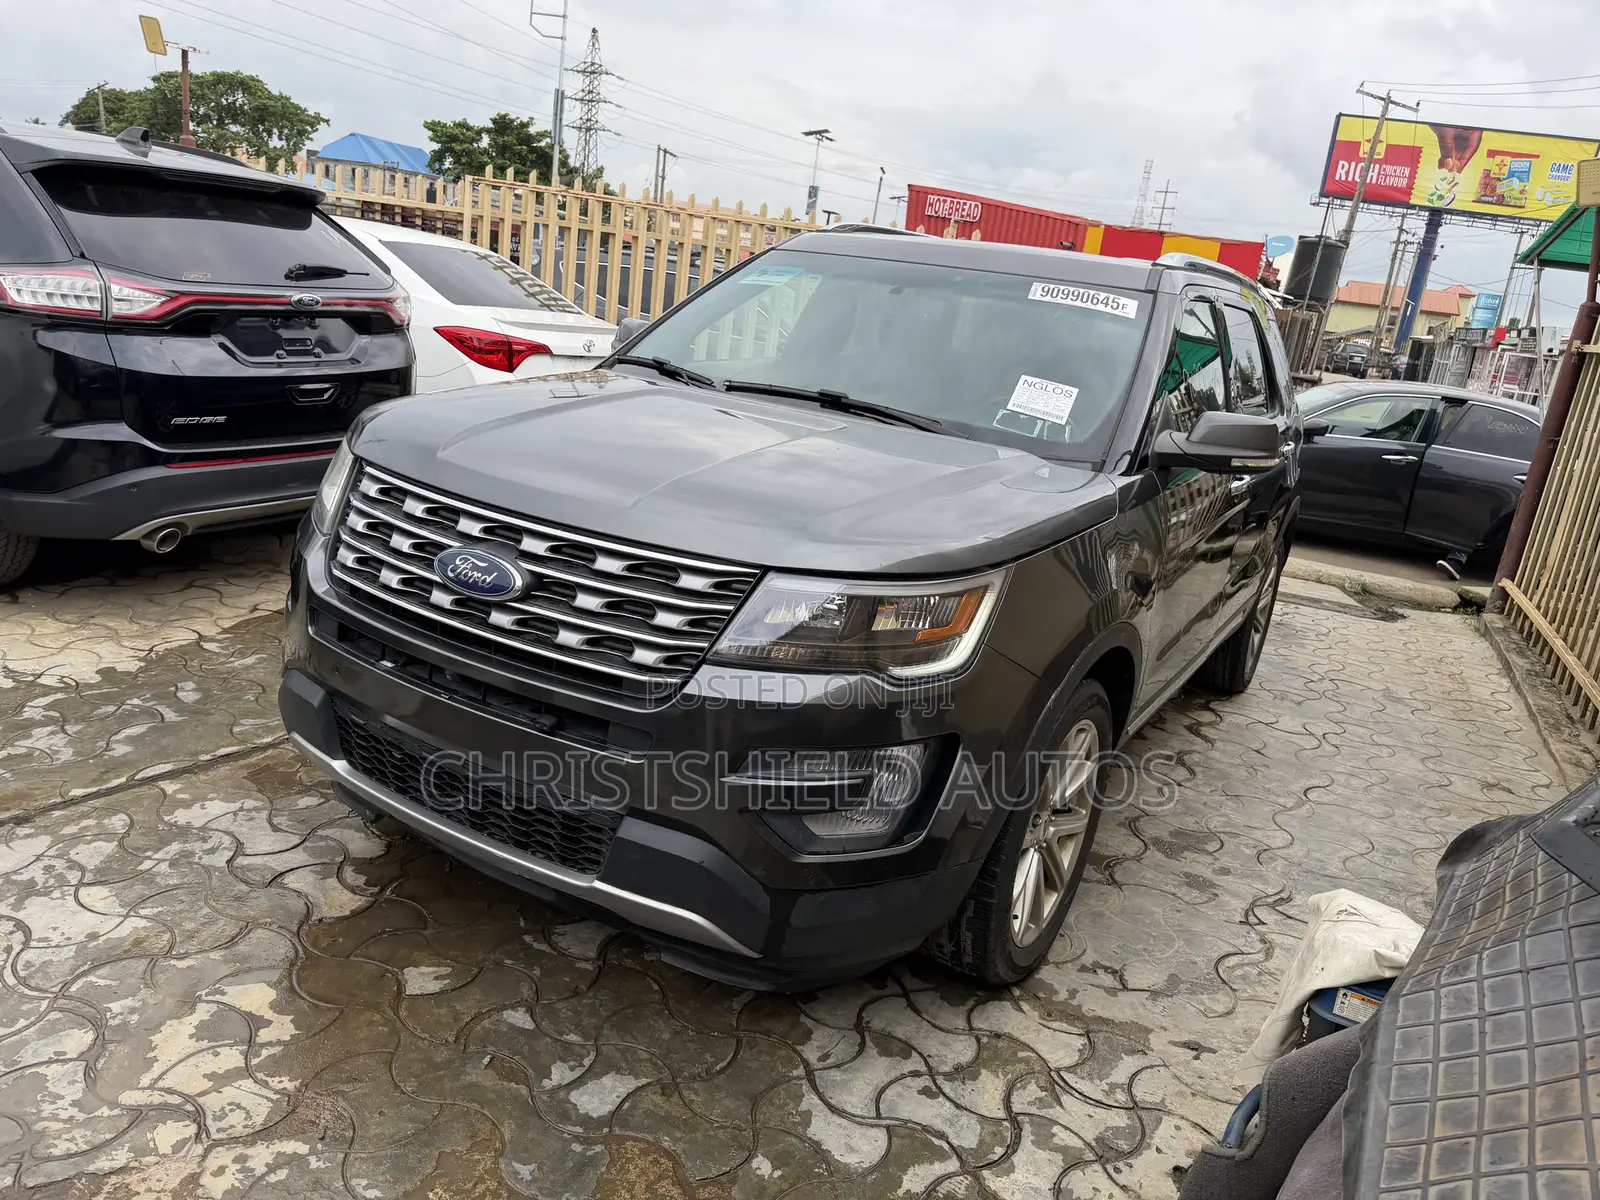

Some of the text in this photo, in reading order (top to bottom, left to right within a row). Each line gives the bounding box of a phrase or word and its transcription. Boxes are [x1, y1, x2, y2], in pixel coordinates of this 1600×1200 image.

[1335, 160, 1379, 184] RICH
[1380, 164, 1411, 177] CHICKEN
[1378, 174, 1408, 187] FLAVOUR
[1022, 379, 1074, 398] NGLOS
[170, 416, 227, 424] EDGE
[447, 555, 498, 588] Ford
